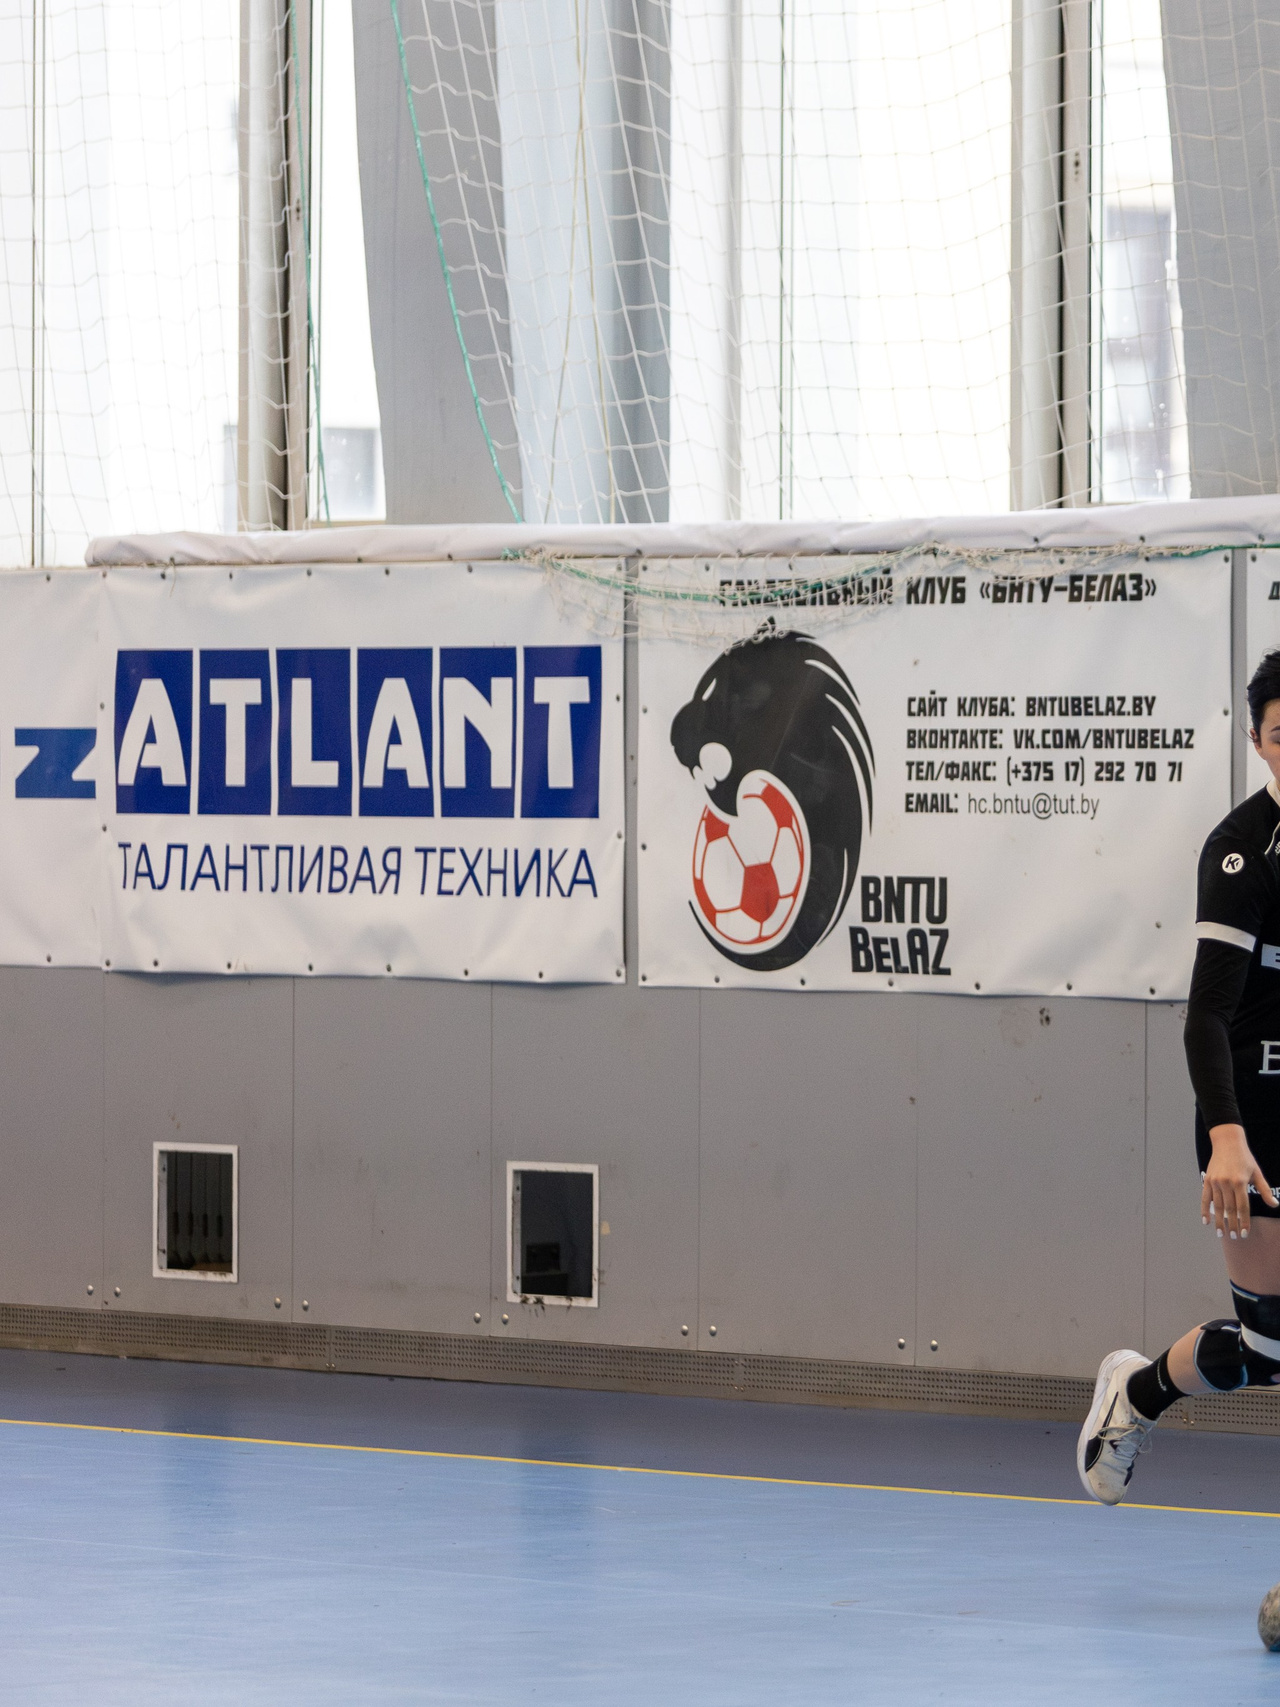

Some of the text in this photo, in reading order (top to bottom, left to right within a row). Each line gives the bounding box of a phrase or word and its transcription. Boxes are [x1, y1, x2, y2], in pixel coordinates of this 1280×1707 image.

[906, 577, 966, 604] КЛУБ
[907, 690, 1156, 717] САЙТ КЛУБА: BNTUBELAZ.BY
[117, 674, 592, 790] ATLANT
[906, 728, 1195, 749] ВКОНТАКТЕ: VK.COM/BNTUBELAZ
[906, 756, 1183, 787] ТЕЛ/ФАКС: (+375 17) 292 70 71
[904, 792, 1098, 820] EMAIL: hc.bntu@tut.by
[117, 842, 598, 898] ТАЛАНТЛИВАЯ ТЕХНИКА
[860, 875, 947, 924] BNTU
